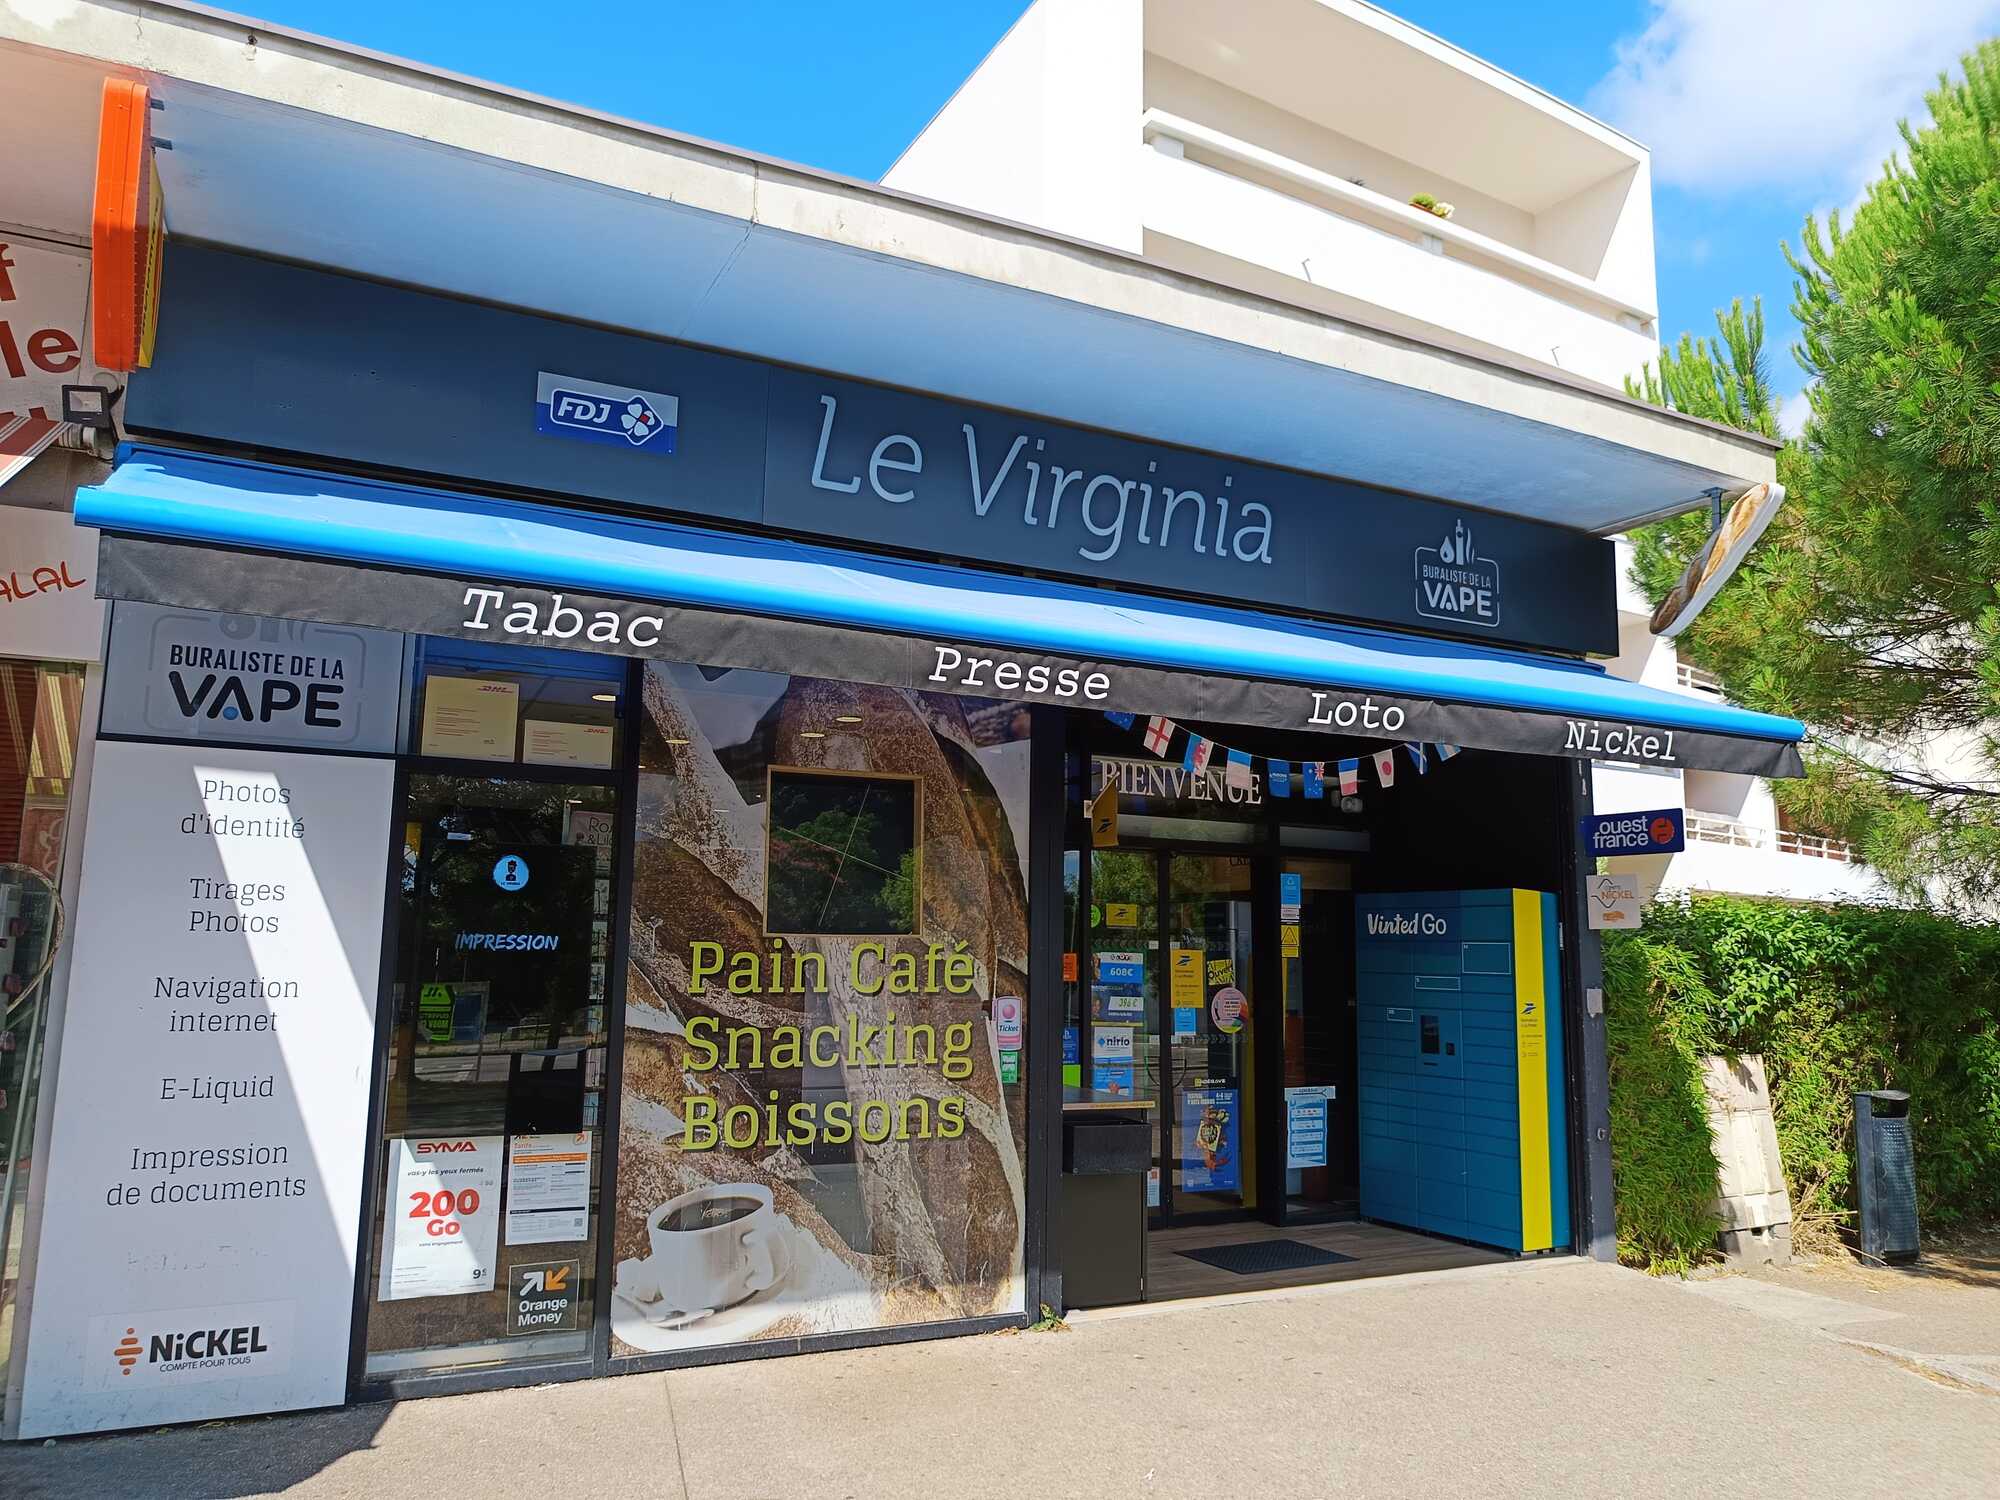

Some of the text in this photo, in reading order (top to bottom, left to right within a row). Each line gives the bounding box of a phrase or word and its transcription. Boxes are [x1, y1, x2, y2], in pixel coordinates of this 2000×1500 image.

[557, 396, 611, 424] FDJ
[811, 395, 1273, 564] Le Virginia
[1422, 564, 1491, 589] BURALISTE DE LA
[1423, 580, 1493, 617] VAPE
[462, 588, 664, 649] Tabac
[169, 644, 344, 680] BURALISTE DE LA
[928, 646, 1111, 700] Presse
[168, 670, 345, 728] VAPE
[1307, 692, 1405, 732] Loto
[1564, 721, 1676, 761] Nickel
[202, 779, 290, 804] Photos
[181, 812, 305, 838] d'identité
[1599, 816, 1648, 835] ouest
[1593, 830, 1648, 849] france
[190, 877, 286, 906] Tirages
[188, 910, 279, 933] Photos
[1367, 912, 1447, 935] Vinted Go
[454, 931, 559, 951] IMPRESSION
[688, 937, 974, 995] Pain Café
[153, 976, 300, 1004] Navigation
[168, 1009, 278, 1032] internet
[682, 1009, 974, 1079] Snacking
[1106, 1036, 1130, 1046] nirio
[160, 1075, 275, 1104] E-Liquid
[682, 1089, 966, 1151] Boissons
[131, 1143, 289, 1174] Impression
[416, 1141, 477, 1154] SYMA
[106, 1177, 306, 1206] de documents
[408, 1189, 480, 1218] 200
[426, 1219, 461, 1236] Go
[518, 1297, 568, 1313] Orange
[517, 1312, 562, 1327] Money
[149, 1326, 267, 1363] NiCKEL
[159, 1355, 251, 1373] COMPTE POUR TOUS
